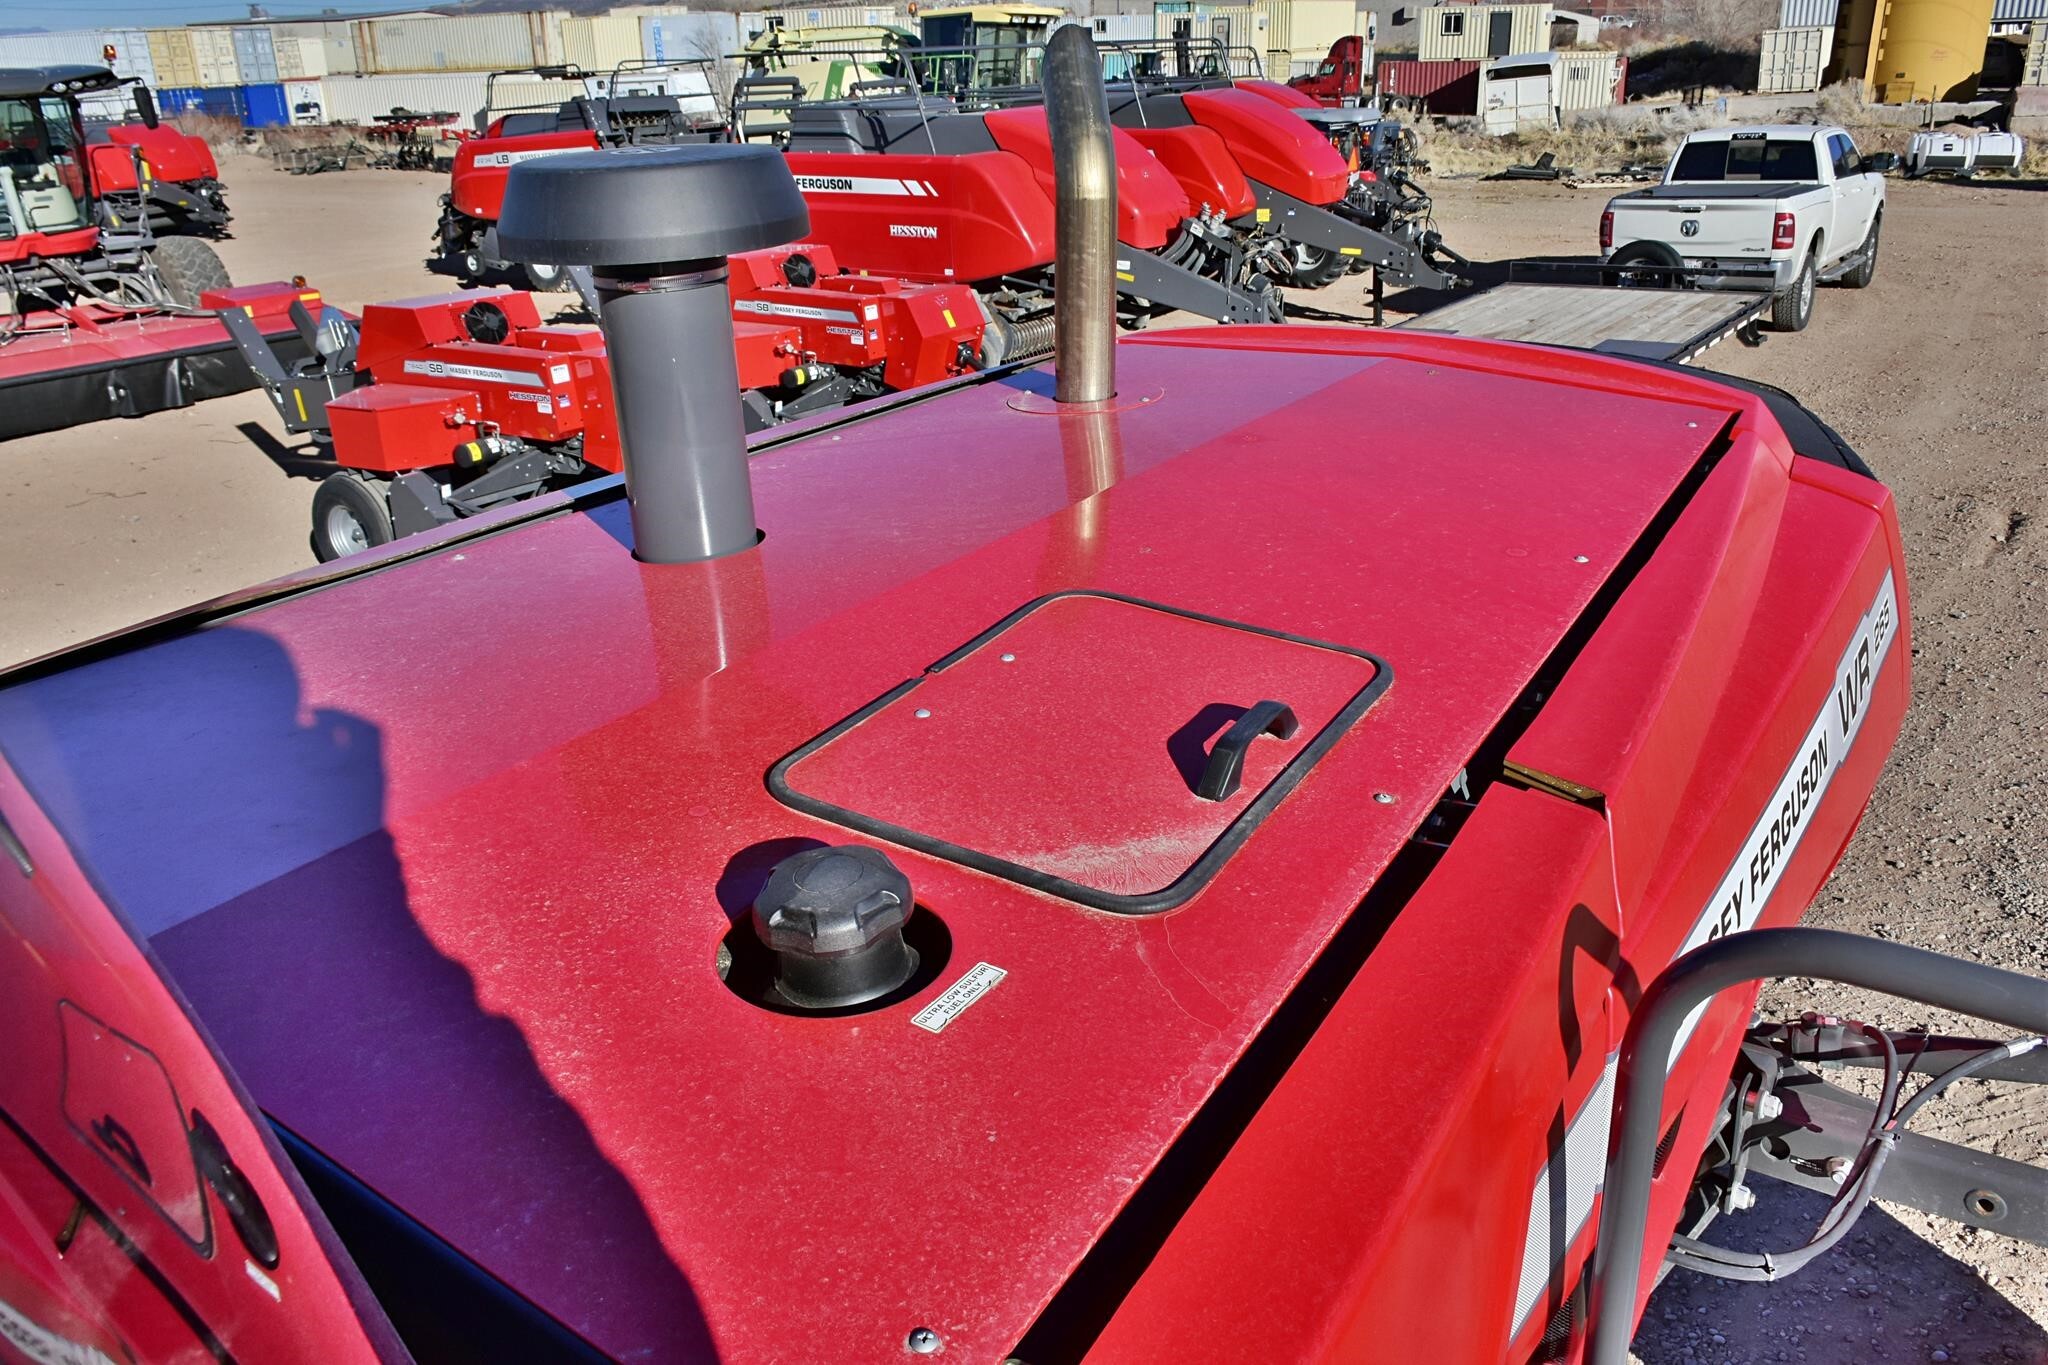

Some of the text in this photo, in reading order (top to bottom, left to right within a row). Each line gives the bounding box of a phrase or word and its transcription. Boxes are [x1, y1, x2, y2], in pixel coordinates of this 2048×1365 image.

[496, 154, 509, 164] LB
[796, 178, 852, 190] FERGUSON
[889, 224, 937, 239] HESSTON
[756, 303, 769, 312] SB
[774, 305, 795, 313] MASSEY
[795, 307, 822, 316] FERGUSON
[429, 363, 443, 374] SB
[449, 367, 471, 375] MASSEY
[473, 368, 503, 379] FERGUSON
[1750, 730, 1829, 904] FERGUSON
[1837, 635, 1870, 738] WR
[1873, 599, 1890, 653] 265
[918, 966, 989, 1024] ULTRA LOW SULFUR
[943, 981, 982, 1014] FUEL ONLY
